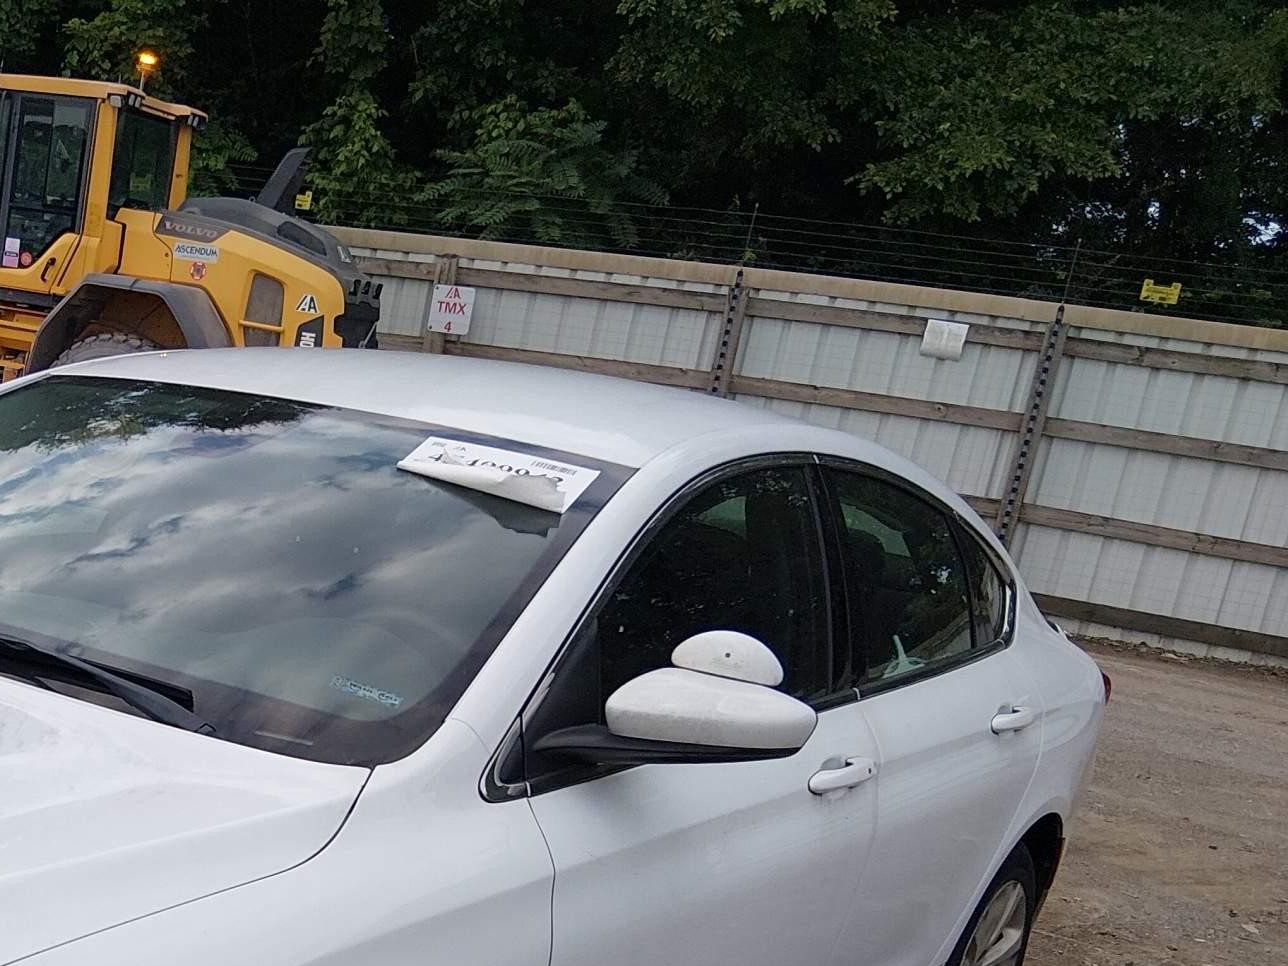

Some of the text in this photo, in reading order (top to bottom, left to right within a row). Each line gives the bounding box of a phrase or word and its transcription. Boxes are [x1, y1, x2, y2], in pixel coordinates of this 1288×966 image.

[164, 220, 218, 239] VOLVO
[175, 244, 218, 257] ASCENDUM
[437, 300, 467, 316] TMX
[443, 321, 452, 333] 4
